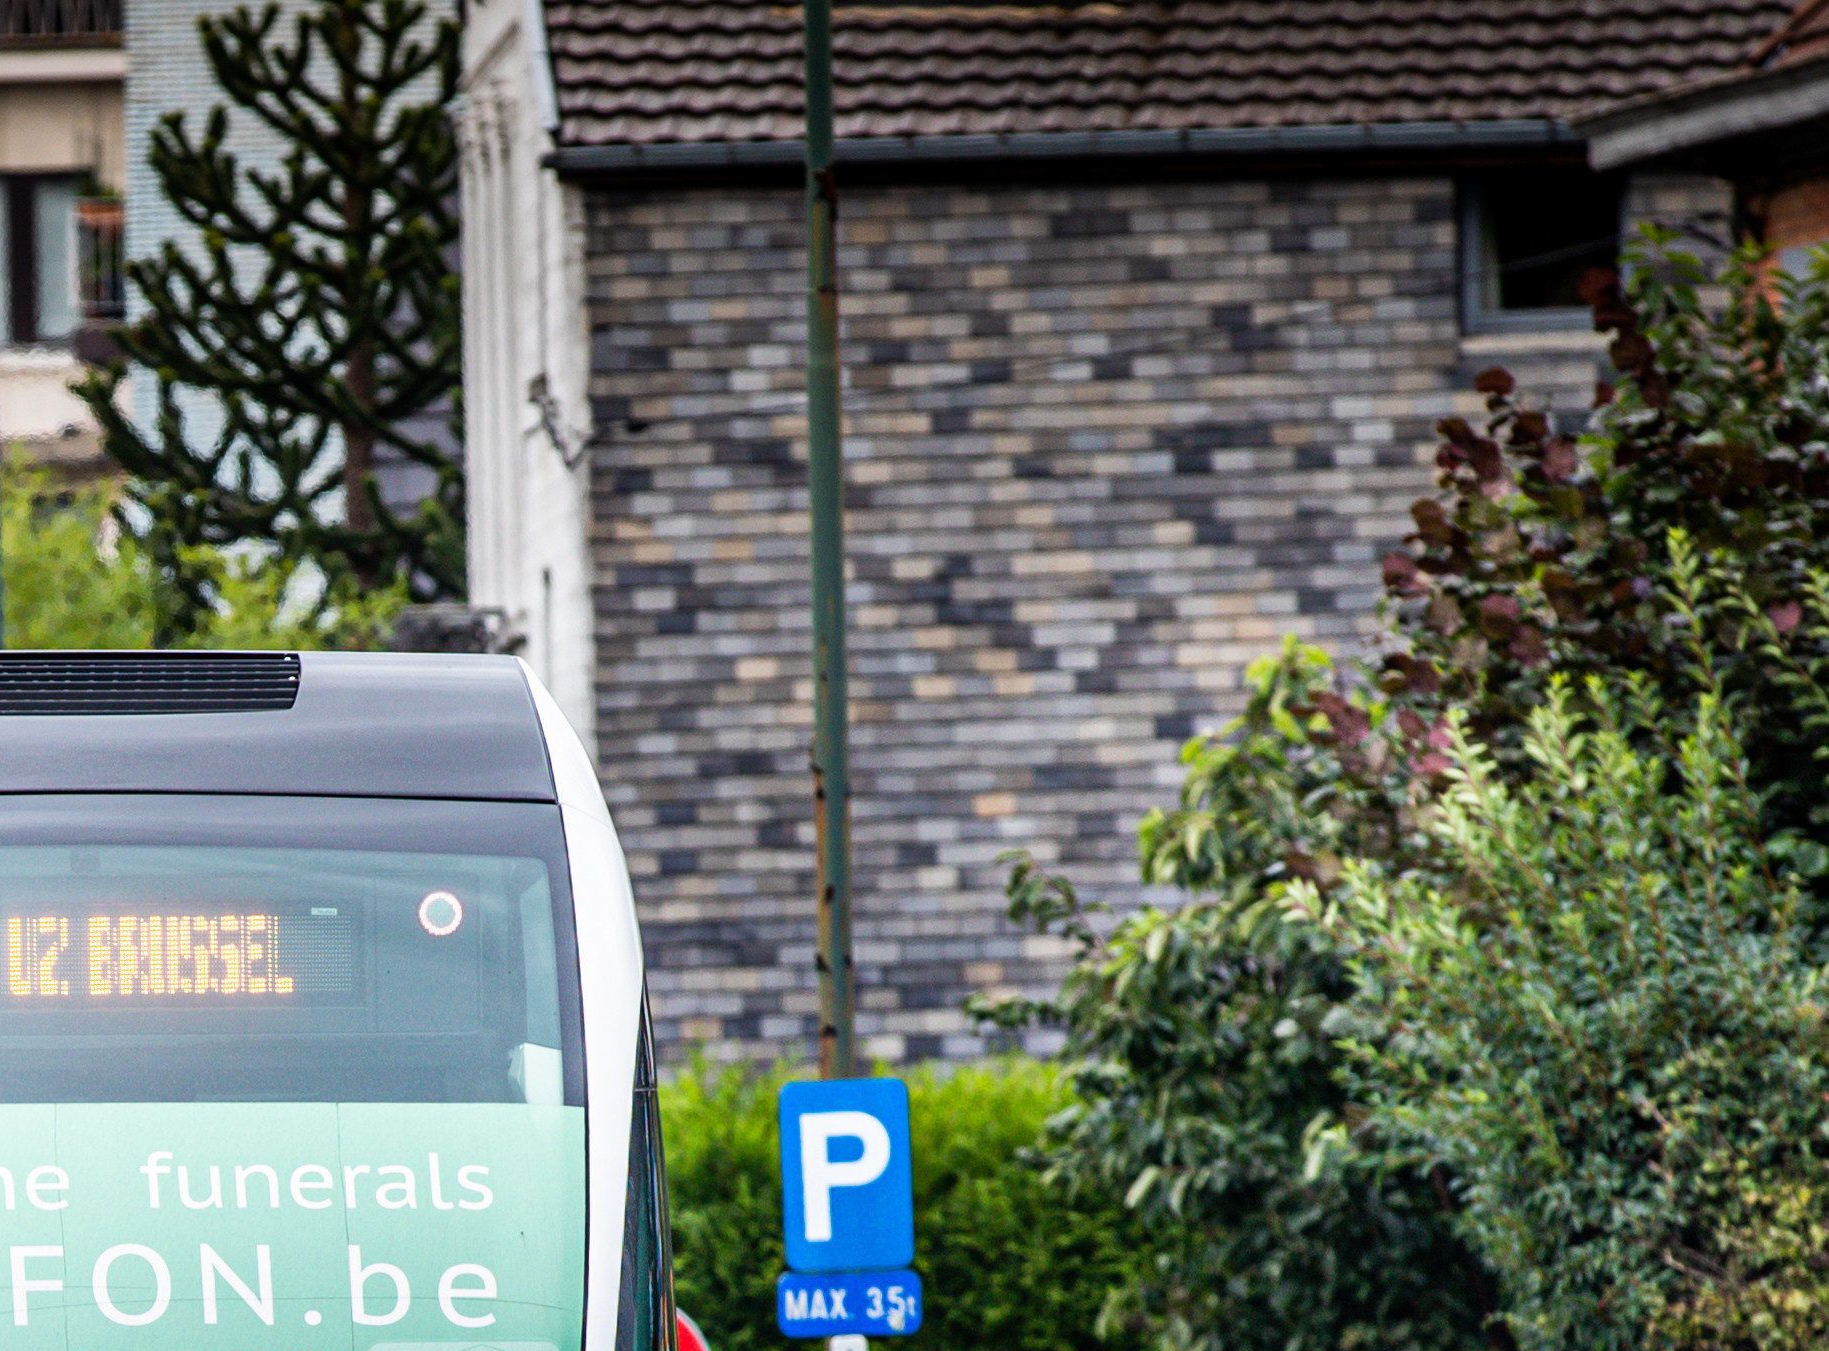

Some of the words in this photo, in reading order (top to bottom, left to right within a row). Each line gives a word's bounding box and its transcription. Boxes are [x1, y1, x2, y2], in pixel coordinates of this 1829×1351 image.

[140, 1150, 494, 1211] funerals
[799, 1110, 891, 1242] P
[784, 1288, 849, 1320] MAX
